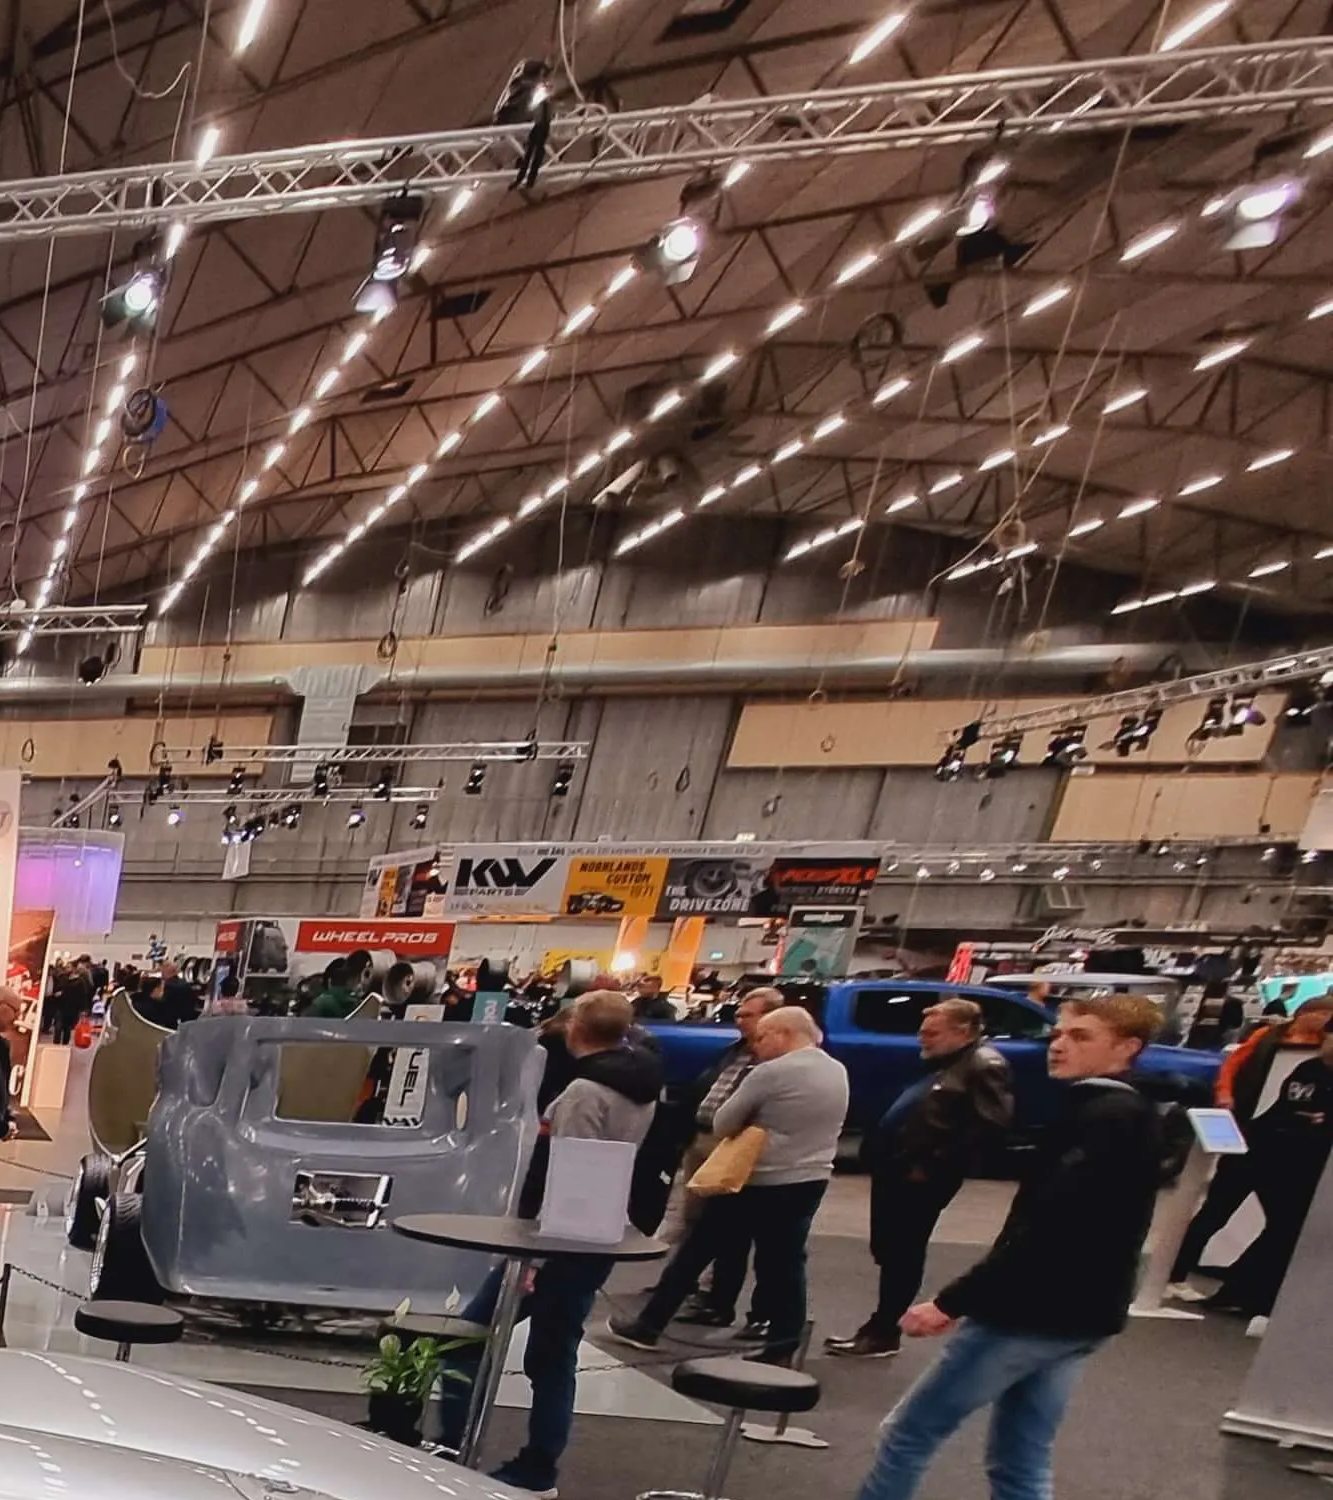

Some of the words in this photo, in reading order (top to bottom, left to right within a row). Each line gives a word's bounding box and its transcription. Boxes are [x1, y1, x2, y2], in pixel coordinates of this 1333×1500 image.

[456, 858, 558, 888] KW
[606, 873, 651, 885] CUSTOM
[311, 930, 379, 944] WHEEL
[380, 931, 439, 944] PROS
[400, 1048, 424, 1107] UEL
